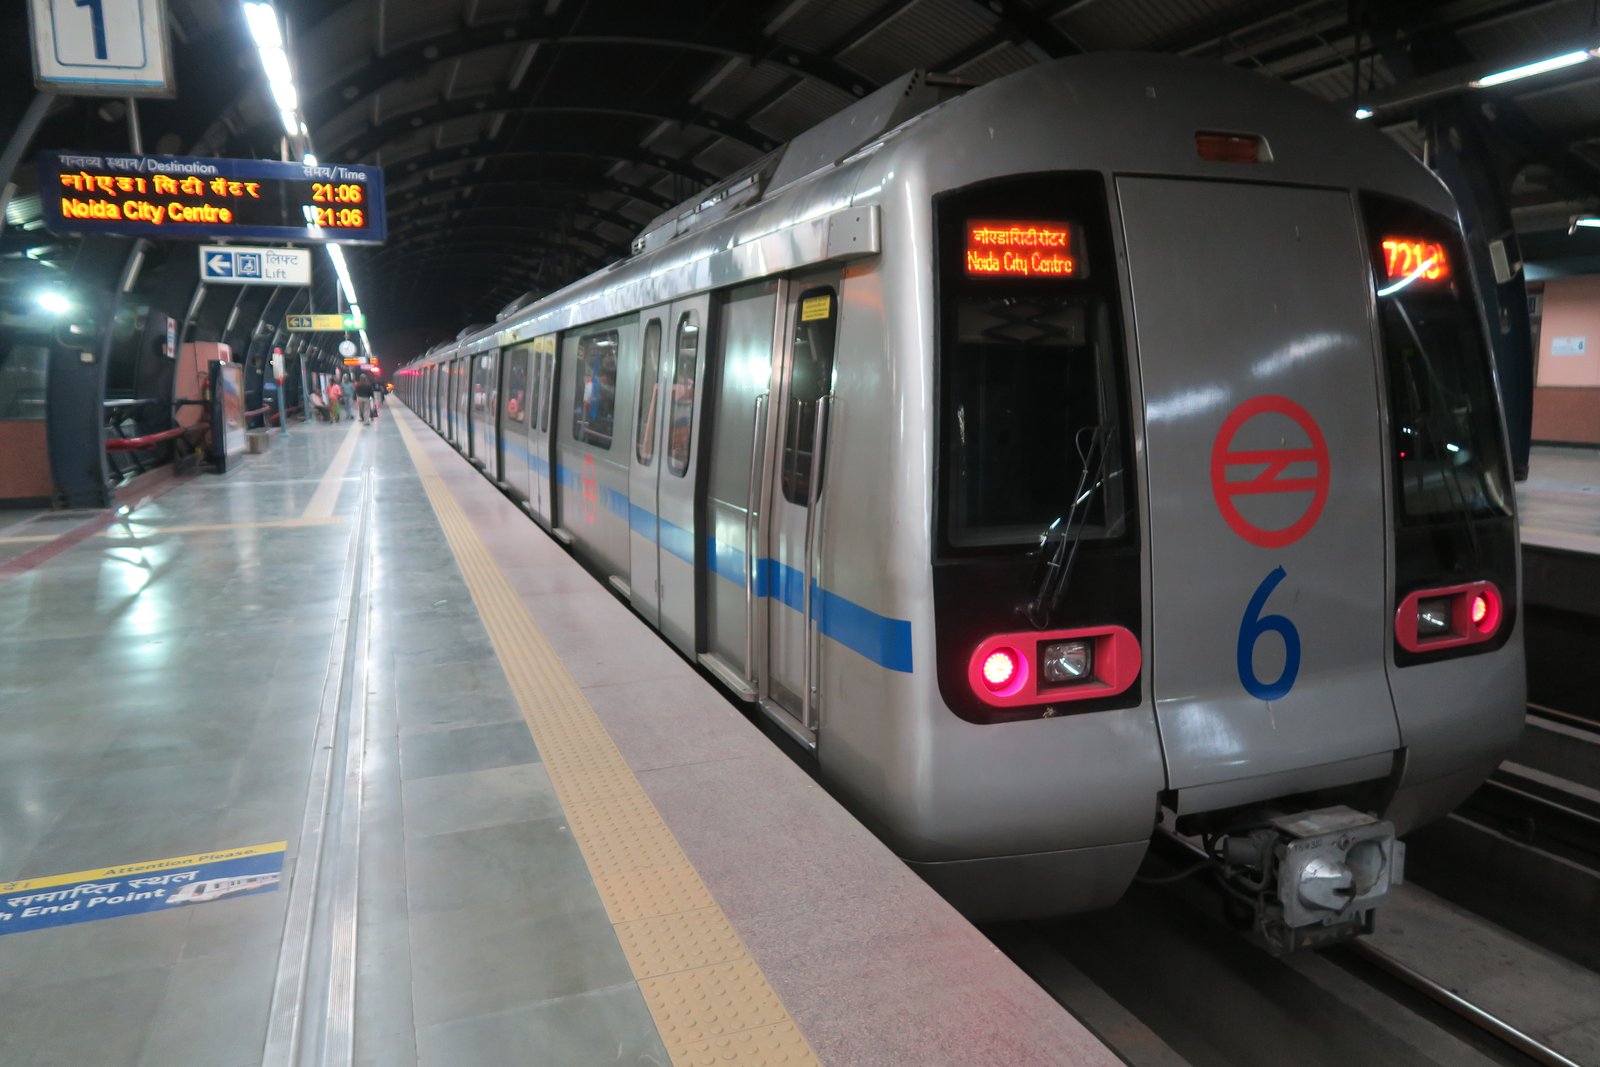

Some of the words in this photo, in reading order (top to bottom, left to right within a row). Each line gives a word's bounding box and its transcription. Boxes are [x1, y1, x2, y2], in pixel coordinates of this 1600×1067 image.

[74, 0, 108, 60] 1
[58, 155, 102, 168] गन्तव्य
[60, 171, 147, 196] नोएडा
[153, 174, 205, 196] सिटी
[312, 182, 362, 204] 21:06
[61, 197, 122, 220] Noida
[123, 200, 166, 225] City
[167, 201, 233, 224] Centre
[316, 207, 364, 228] 21:06
[265, 250, 298, 266] लिफ्ट
[967, 250, 1000, 271] Noida
[1003, 251, 1028, 276] City
[1031, 252, 1072, 273] Centre
[265, 269, 286, 279] Lift
[1236, 564, 1301, 701] 6
[104, 859, 193, 876] Attention
[8, 882, 121, 907] समाप्ति
[128, 870, 199, 889] स्थल
[20, 899, 82, 918] End
[86, 888, 167, 908] Point
